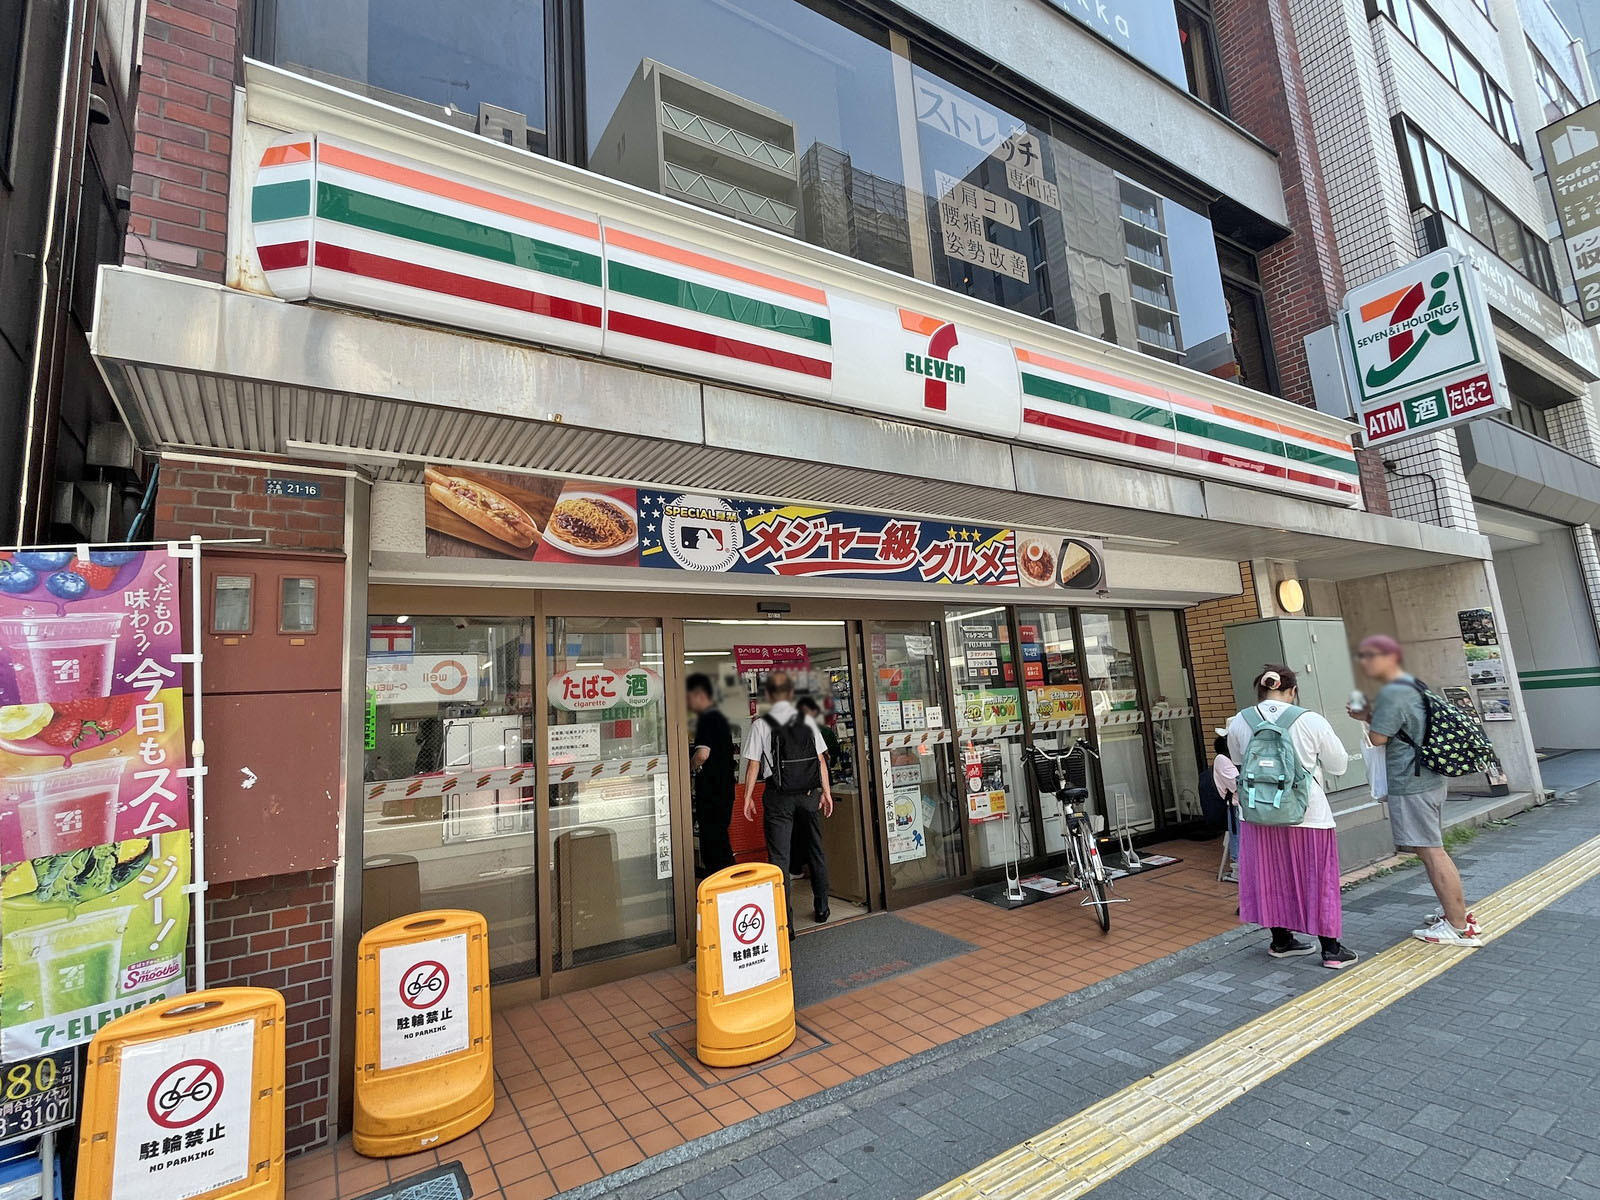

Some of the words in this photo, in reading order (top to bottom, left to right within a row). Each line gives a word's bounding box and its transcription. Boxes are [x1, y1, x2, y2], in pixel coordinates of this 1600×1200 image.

[918, 86, 1039, 168] ストレッチ
[1008, 169, 1058, 205] 専門店
[1556, 160, 1600, 186] Safet
[1558, 170, 1600, 196] Trun
[941, 202, 983, 238] 腰痛
[944, 229, 1028, 280] 姿勢改善
[1402, 301, 1460, 329] HOLDINGS
[1412, 396, 1440, 424] 酒
[1448, 380, 1492, 411] たばこ
[1369, 409, 1402, 435] ATM
[287, 484, 317, 495] 21-16
[744, 517, 922, 563] メジャー級
[918, 541, 1006, 583] グルメ
[152, 562, 174, 636] くだもの
[123, 589, 151, 657] 味わう！
[562, 674, 617, 700] たばこ
[626, 673, 648, 697] 酒
[573, 699, 607, 708] cigarette
[628, 698, 649, 706] liquor
[883, 757, 892, 789] トイレ
[658, 781, 668, 818] トイレ
[885, 800, 896, 833] 未設置
[658, 832, 672, 874] 未設置
[733, 943, 770, 963] 駐輪禁止
[748, 957, 767, 968] PARKING
[123, 961, 181, 991] Smoothie
[397, 1007, 453, 1031] 駐輪禁止
[404, 1030, 414, 1040] NO
[415, 1025, 447, 1038] PARKING
[0, 1056, 58, 1102] 80
[139, 1122, 226, 1161] 駐輪禁止
[149, 1161, 166, 1174] NO
[166, 1147, 215, 1170] PARKING
